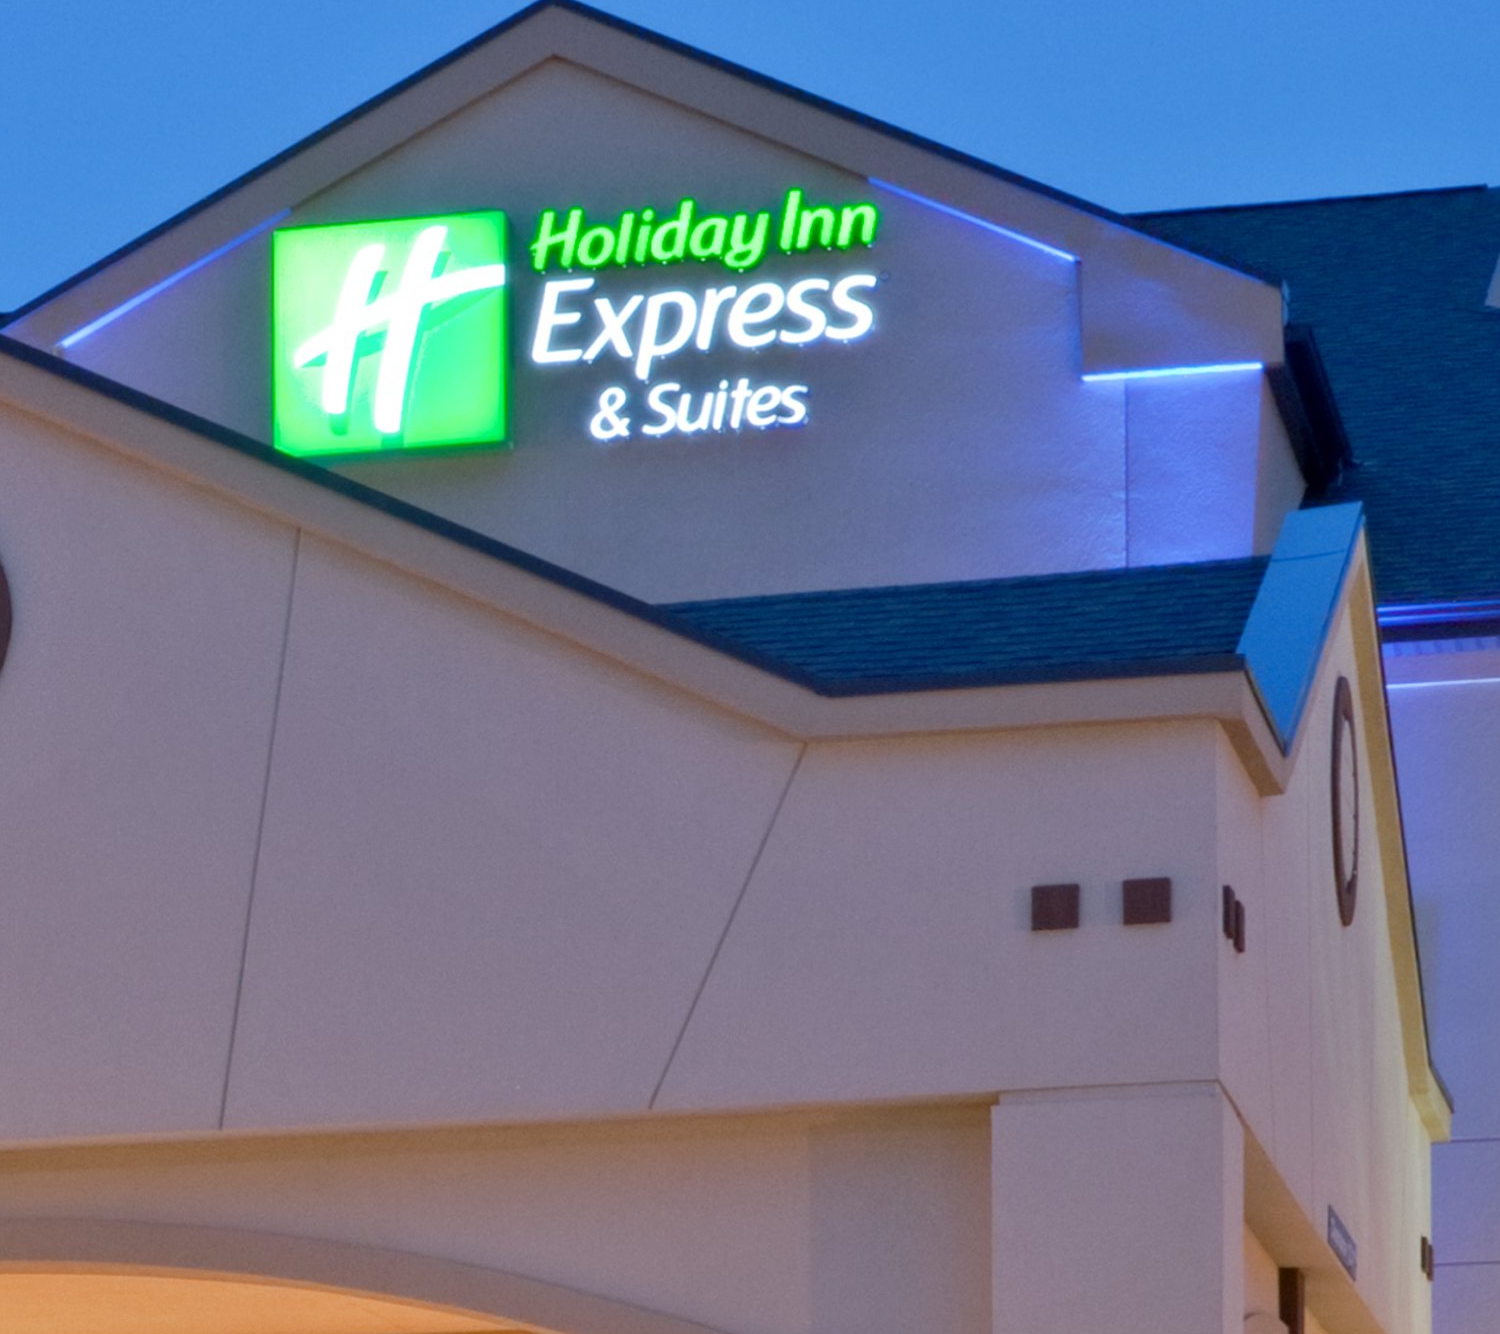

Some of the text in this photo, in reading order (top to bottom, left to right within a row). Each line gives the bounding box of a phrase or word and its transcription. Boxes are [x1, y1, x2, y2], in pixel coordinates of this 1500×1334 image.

[530, 189, 876, 271] Holiday Inn
[531, 273, 877, 380] Express
[589, 377, 809, 440] & Suites
